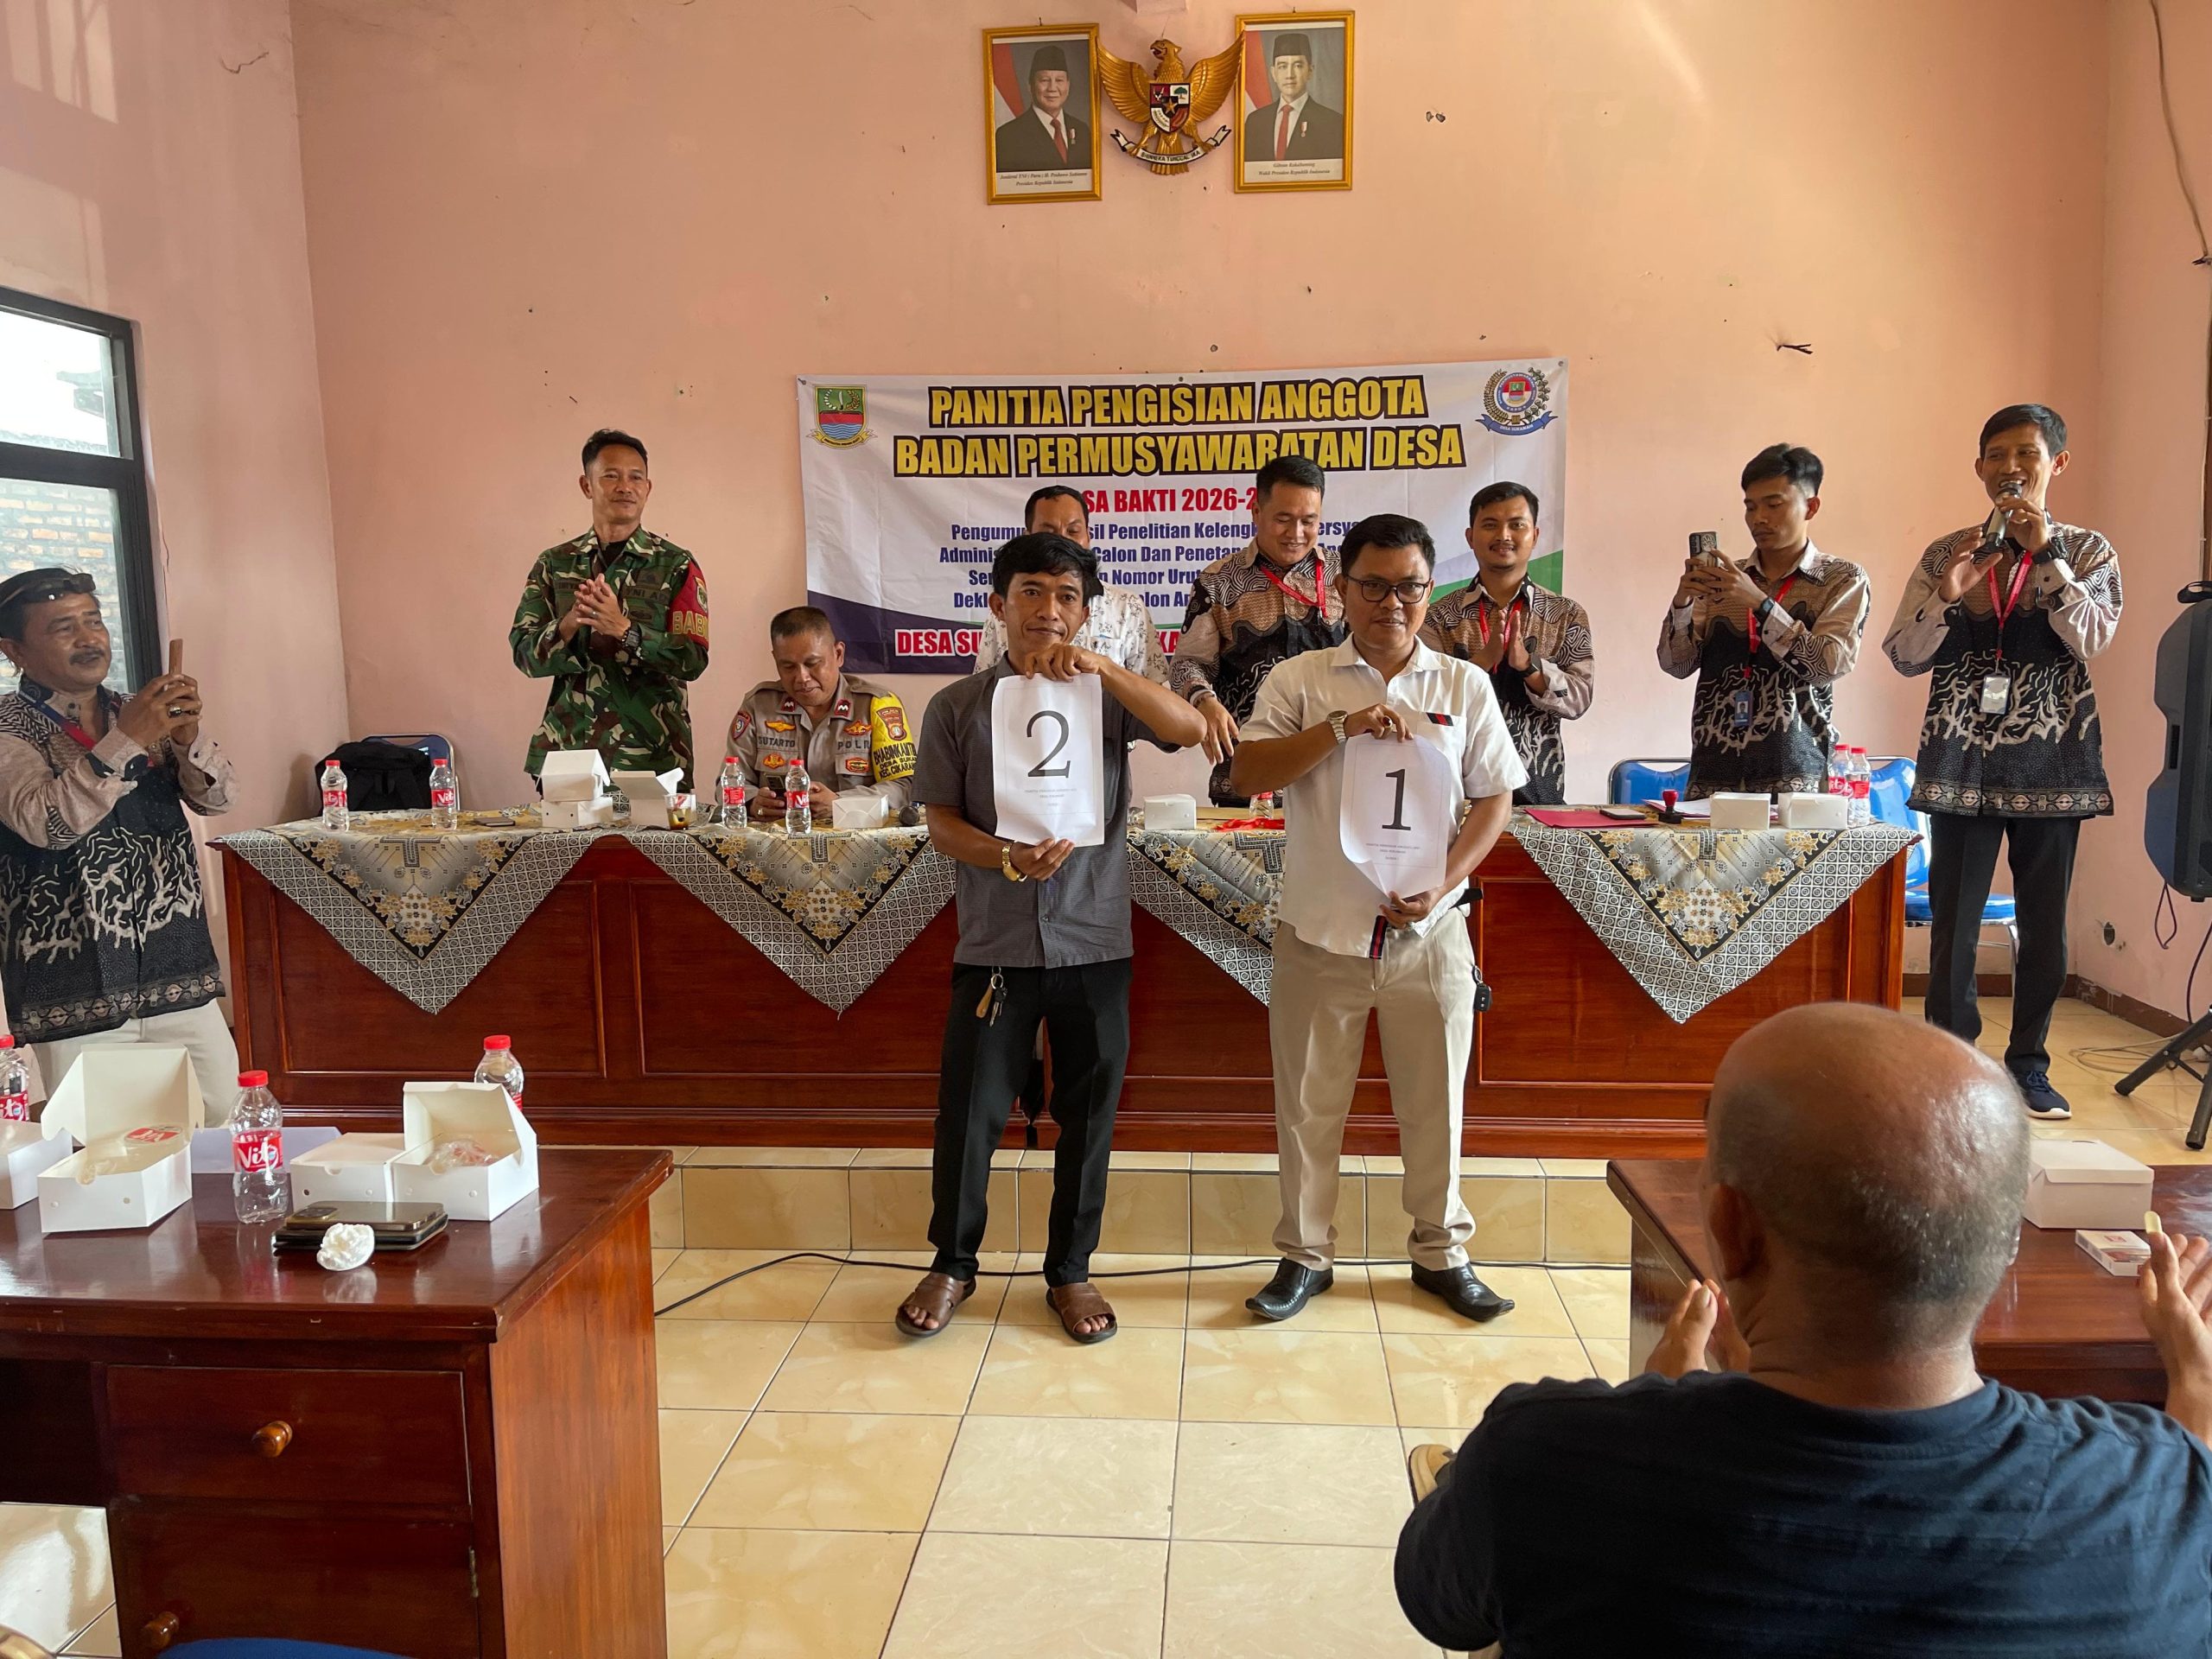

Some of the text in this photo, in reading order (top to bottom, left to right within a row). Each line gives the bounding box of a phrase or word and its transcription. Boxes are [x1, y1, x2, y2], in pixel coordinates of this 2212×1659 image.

[929, 375, 1428, 427] PANITIA PENGISIAN ANGGOTA
[894, 435, 1012, 478] BADAN
[1370, 424, 1466, 471] DESA
[1083, 487, 1258, 512] SA BAKTI 2026-2
[1090, 524, 1104, 540] sil
[1109, 523, 1191, 540] Penelitian
[1141, 546, 1171, 562] Dan
[1112, 569, 1165, 585] Nomor
[897, 630, 954, 655] DESA
[758, 736, 796, 748] SUTARTO
[1027, 710, 1071, 779] 2
[1382, 768, 1411, 831] 1
